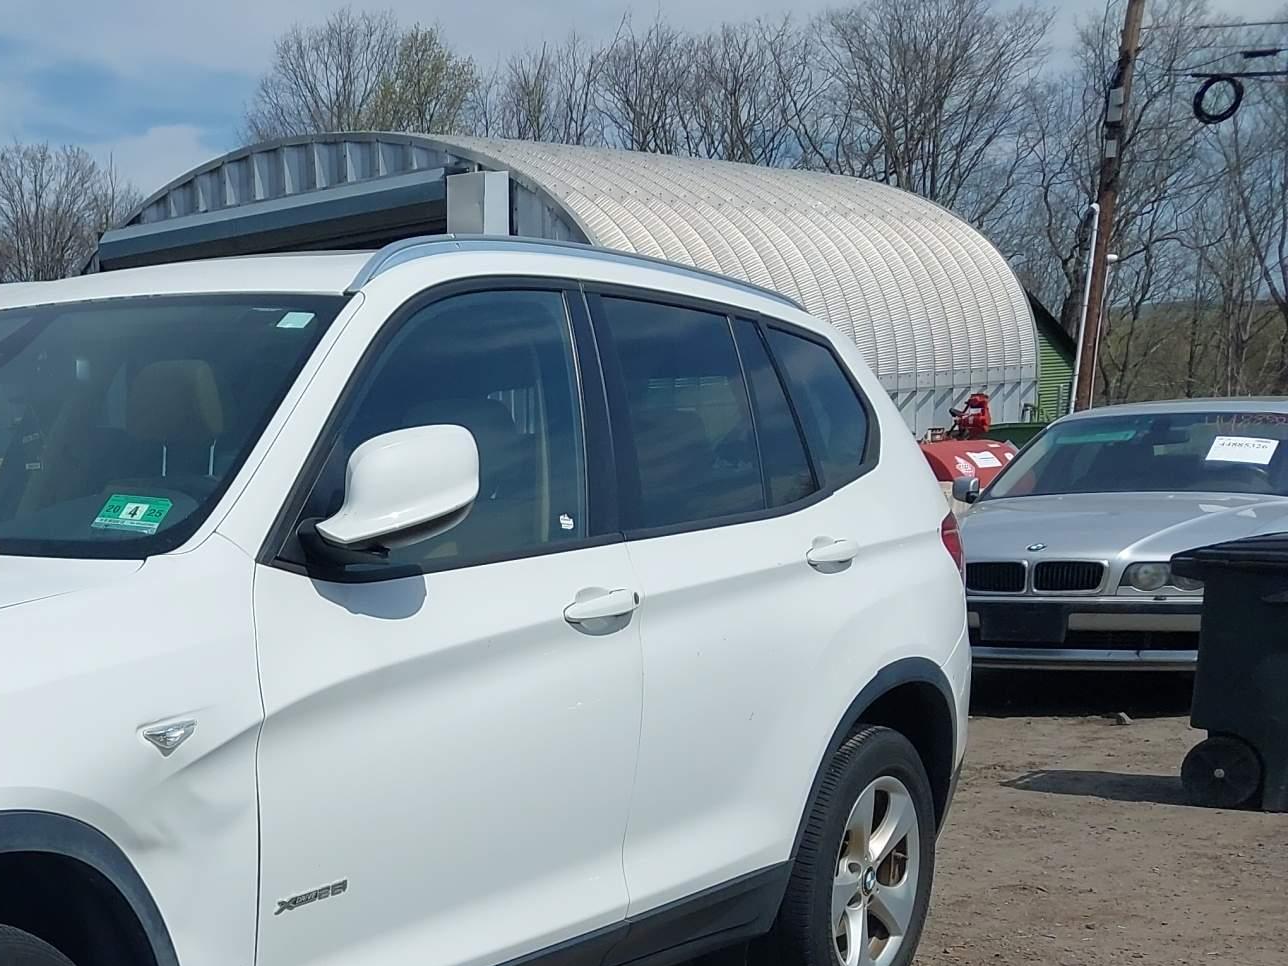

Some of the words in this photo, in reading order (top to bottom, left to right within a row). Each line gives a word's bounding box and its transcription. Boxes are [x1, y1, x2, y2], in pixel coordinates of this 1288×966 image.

[106, 505, 120, 513] 20
[128, 506, 140, 518] 4
[147, 509, 163, 517] 25
